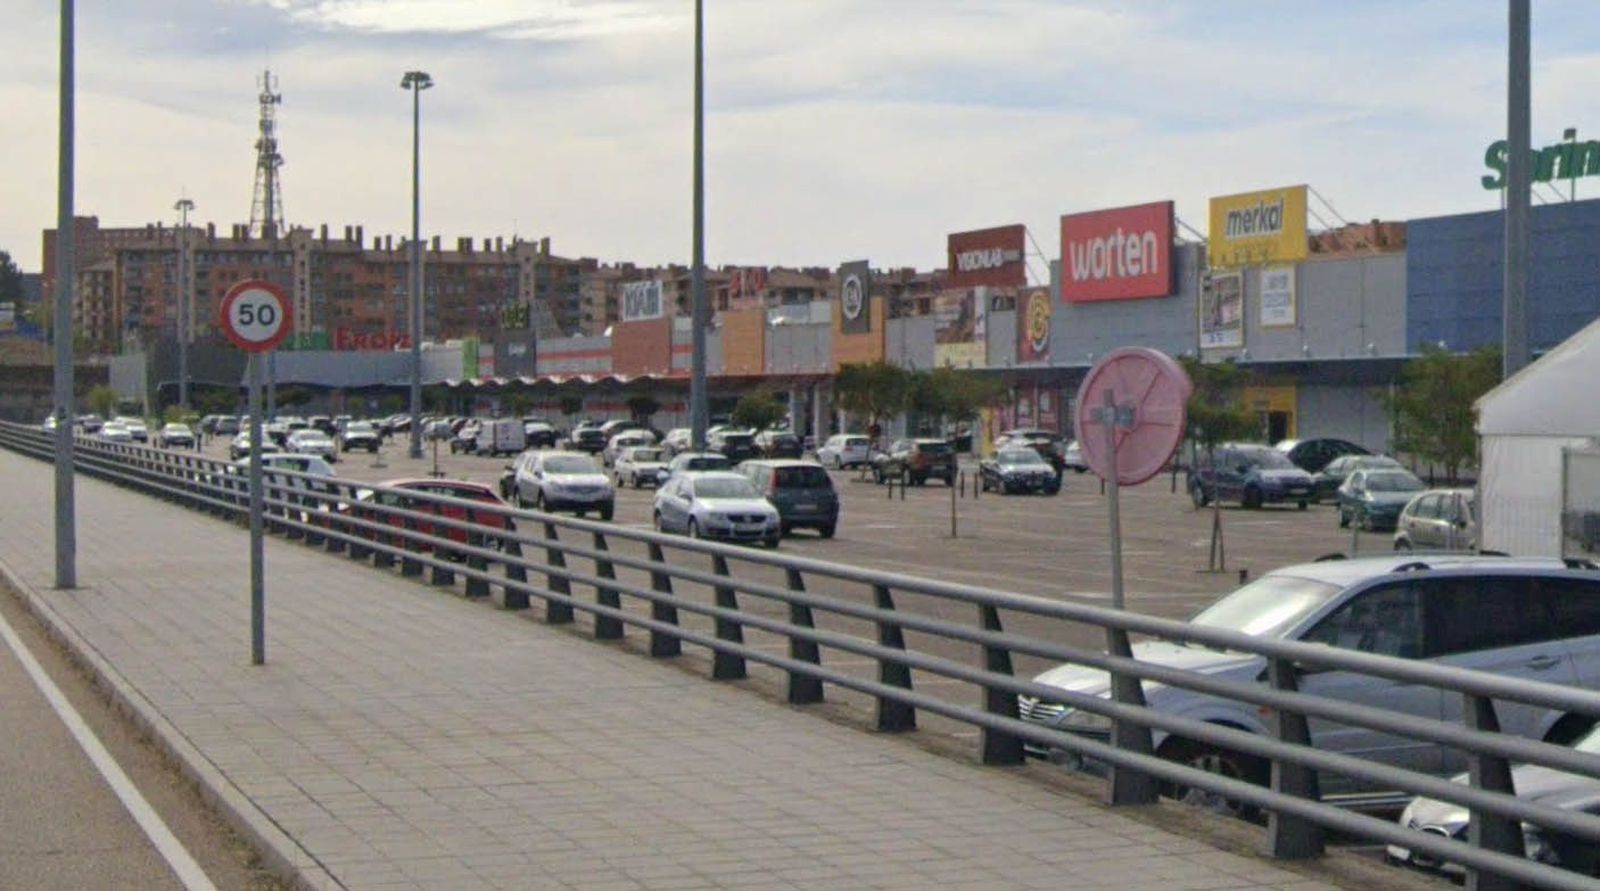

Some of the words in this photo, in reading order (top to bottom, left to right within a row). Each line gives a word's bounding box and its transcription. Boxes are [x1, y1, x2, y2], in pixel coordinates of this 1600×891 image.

[1227, 198, 1284, 237] merkal
[1070, 227, 1157, 281] worten
[239, 304, 275, 326] 50
